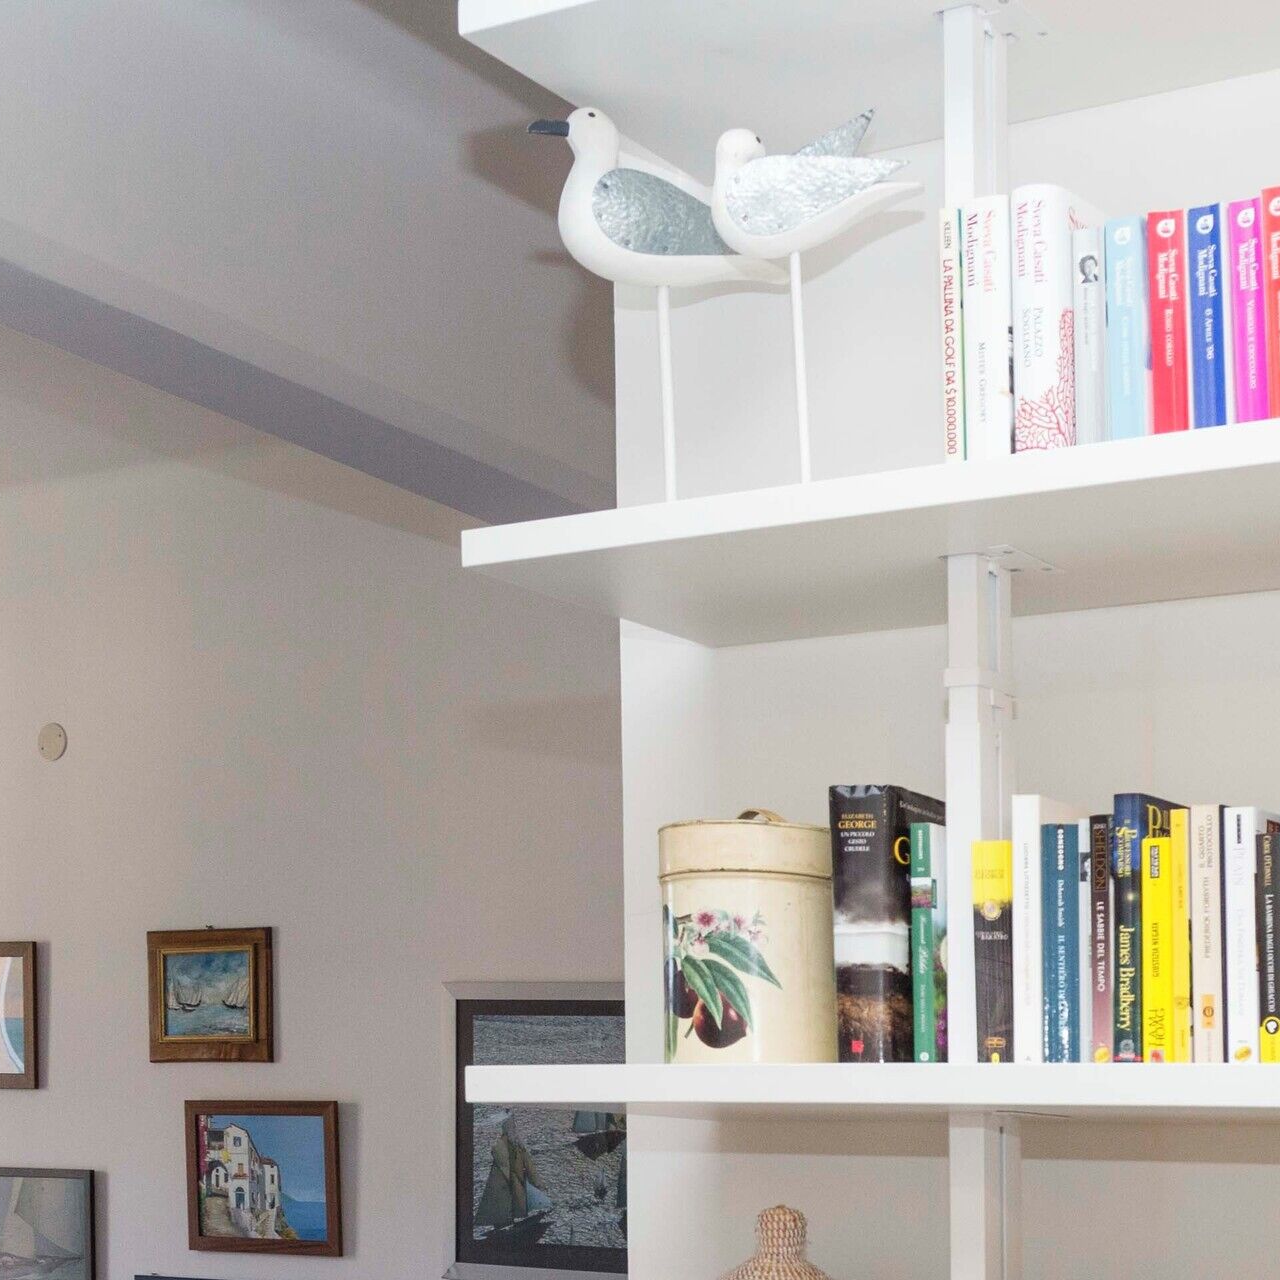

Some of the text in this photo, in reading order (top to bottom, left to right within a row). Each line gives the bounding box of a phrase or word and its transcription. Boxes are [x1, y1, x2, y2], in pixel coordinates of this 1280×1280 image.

[942, 259, 953, 273] LA
[964, 213, 978, 287] Modignani
[983, 209, 996, 292] Sveva Casati
[943, 275, 954, 317] PALLINA
[944, 319, 954, 334] DA
[945, 336, 955, 368] GOLF
[946, 370, 956, 386] DA
[838, 820, 878, 830] GEORGE
[1093, 828, 1107, 992] SHELDON LE SABBIE DEL TEMPO
[1117, 925, 1136, 1031] James Bradberry
